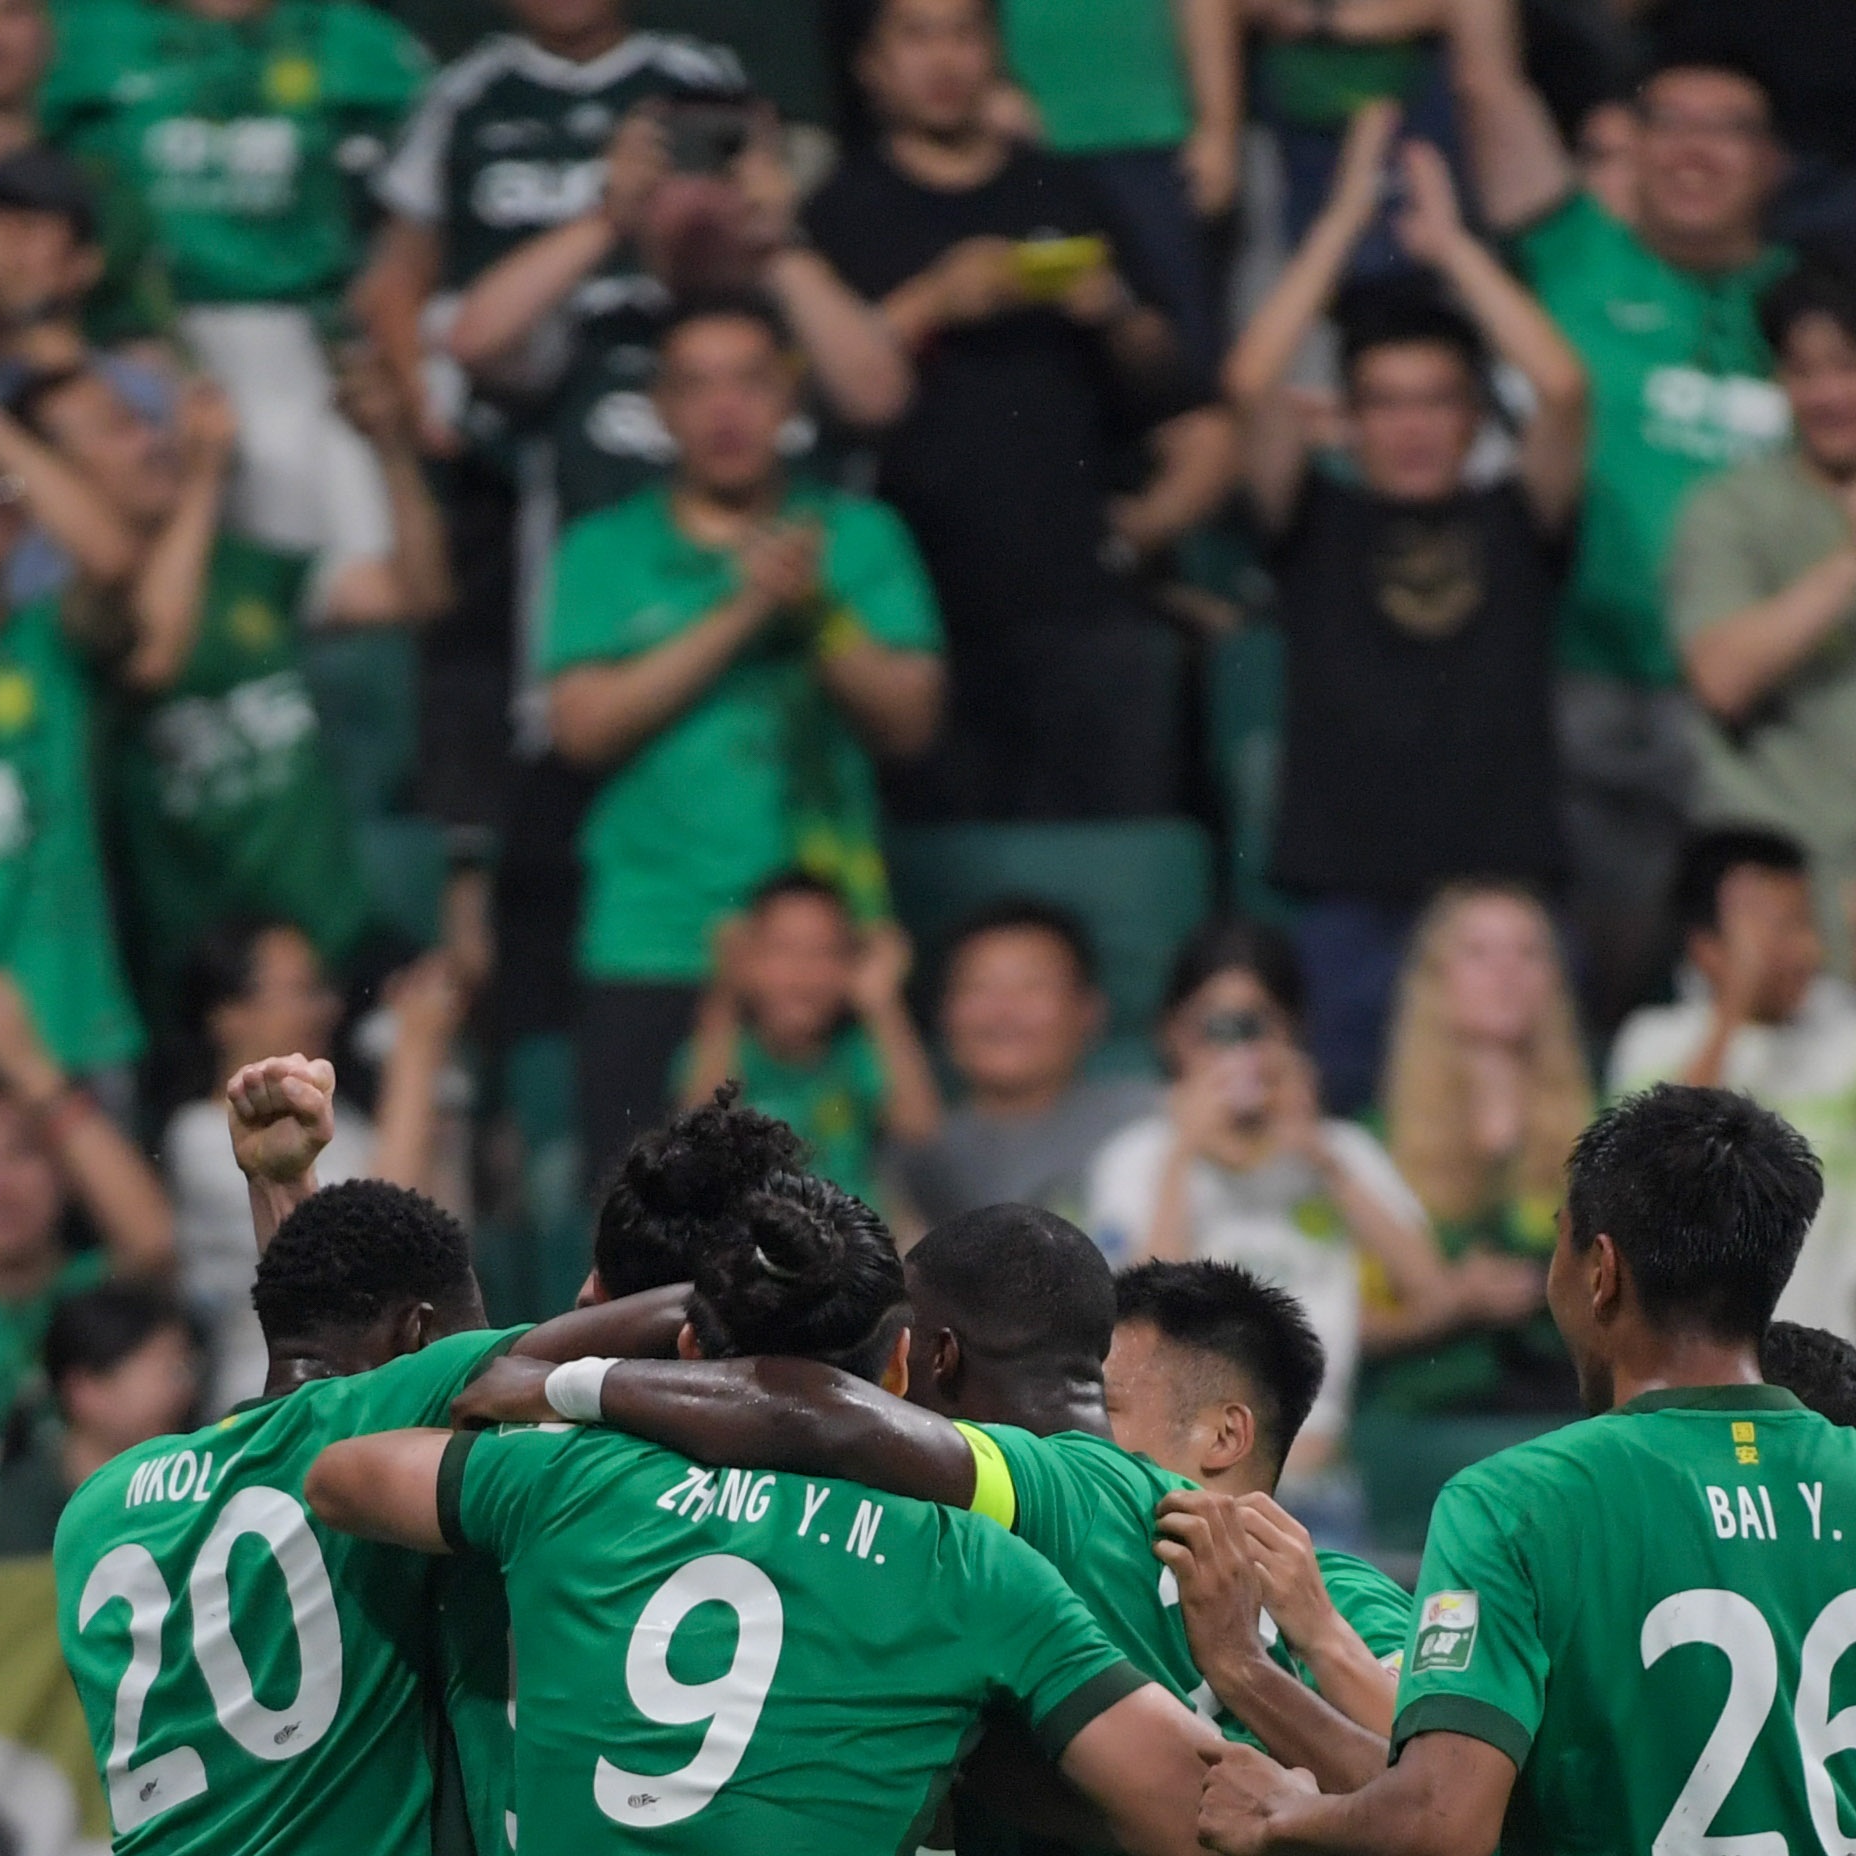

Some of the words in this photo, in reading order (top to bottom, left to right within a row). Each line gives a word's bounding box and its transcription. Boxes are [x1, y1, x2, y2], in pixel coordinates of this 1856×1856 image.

[656, 1466, 776, 1523] ZHNG
[797, 1483, 830, 1544] Y.
[846, 1499, 885, 1565] N.
[1706, 1485, 1777, 1540] BAI
[1797, 1481, 1842, 1541] Y.
[78, 1485, 342, 1834] 20
[593, 1553, 783, 1827] 9
